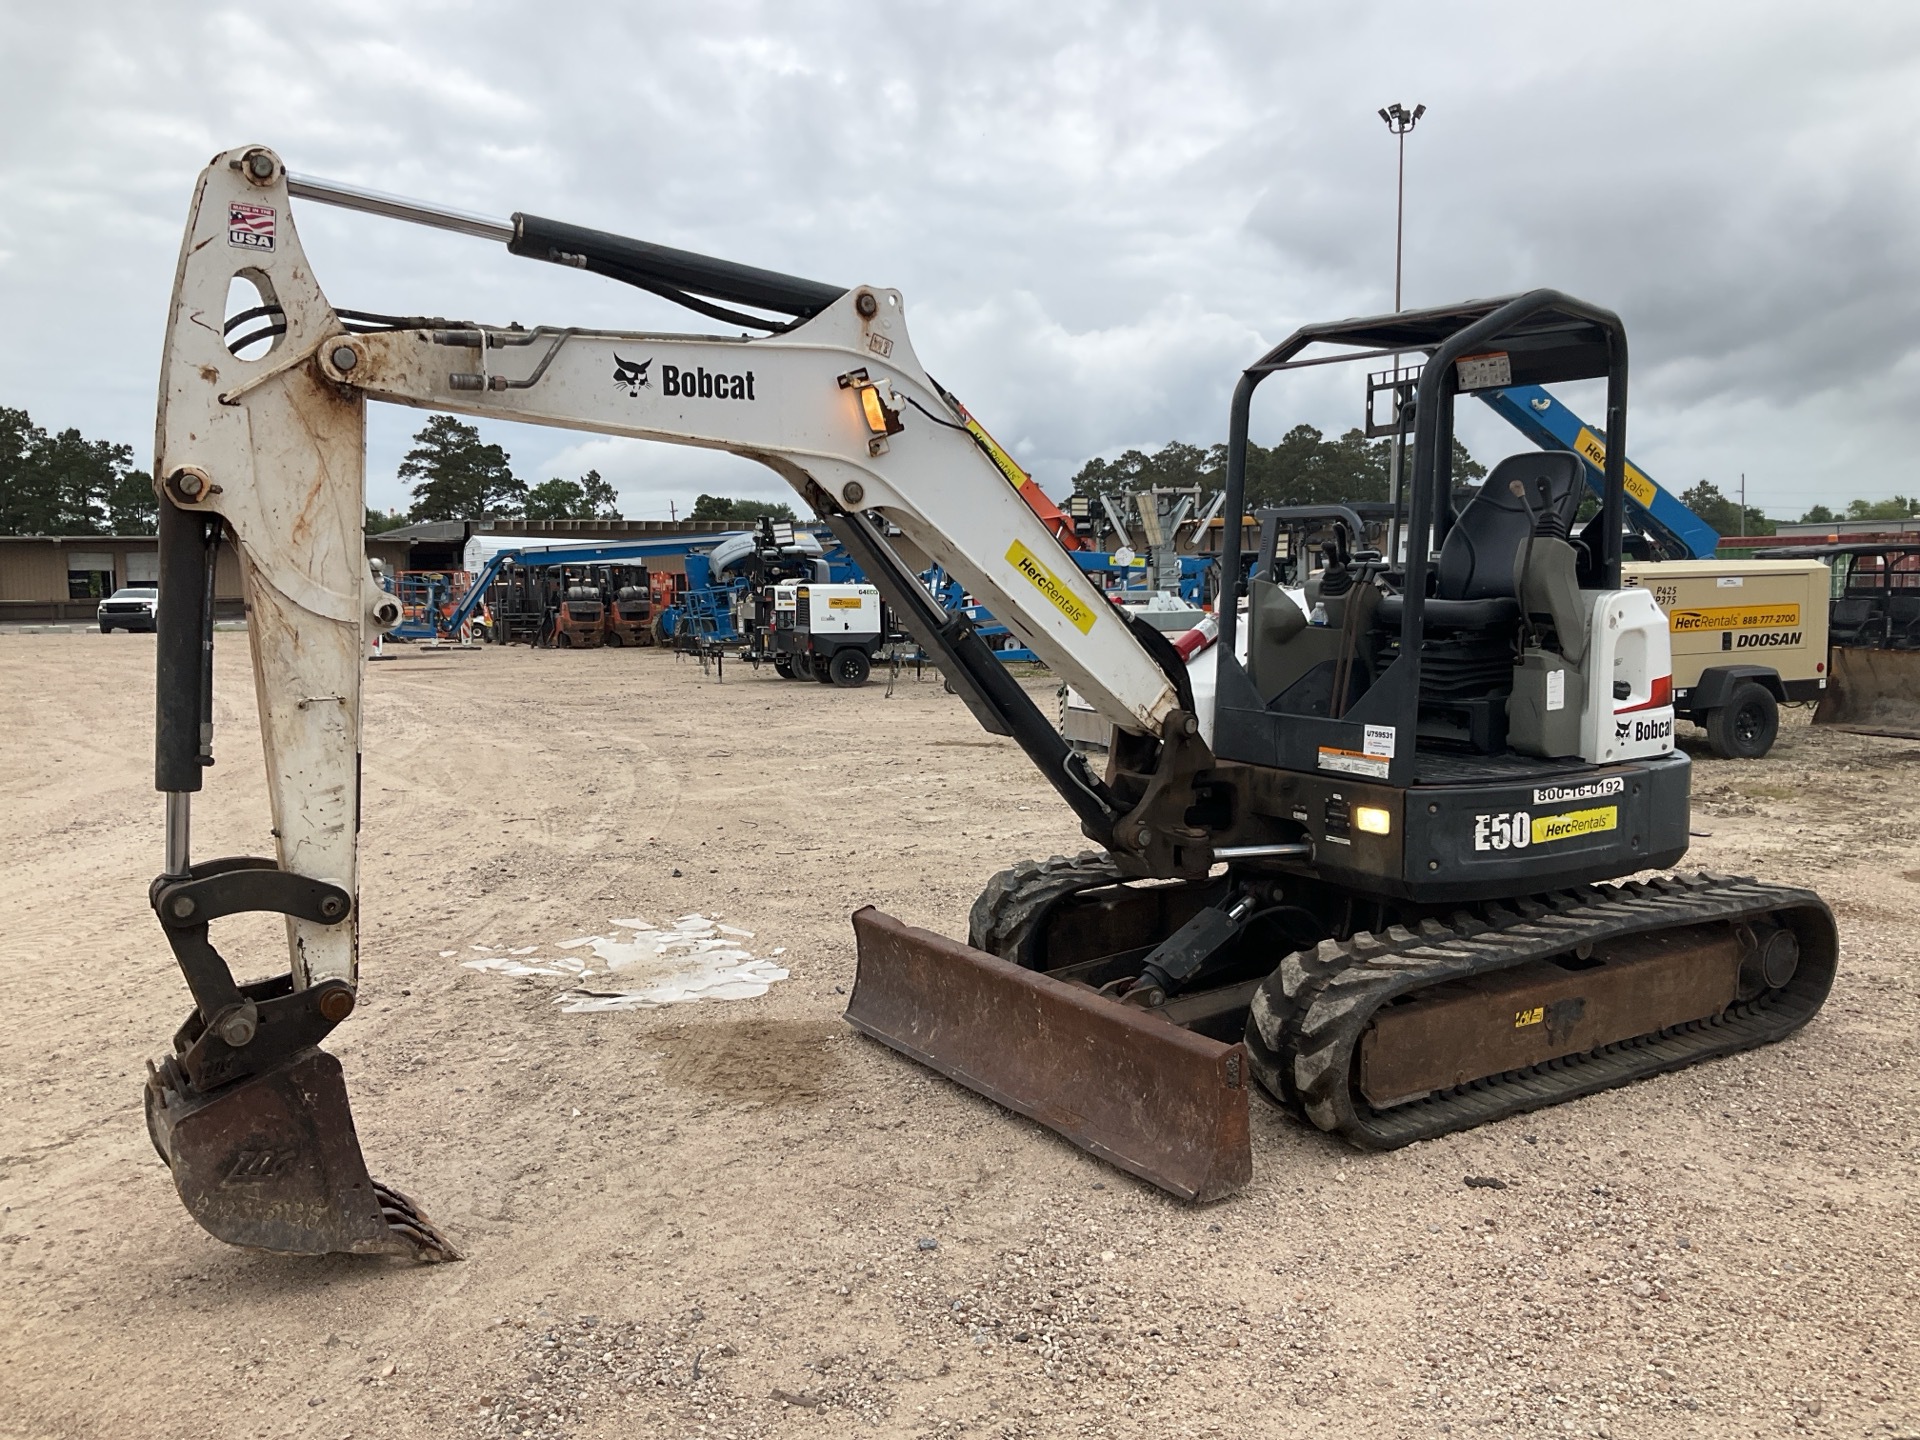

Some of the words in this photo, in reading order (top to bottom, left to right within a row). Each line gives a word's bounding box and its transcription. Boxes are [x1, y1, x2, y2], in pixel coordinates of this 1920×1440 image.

[232, 204, 251, 212] MADE
[231, 231, 271, 248] USA
[662, 364, 755, 401] Bobcat
[1656, 586, 1677, 596] P425
[1742, 614, 1796, 625] 888-777-2700
[1736, 631, 1802, 648] DOOSAN
[1366, 730, 1393, 739] U759531
[1538, 780, 1621, 801] 800-16-0192
[1474, 811, 1531, 851] E50
